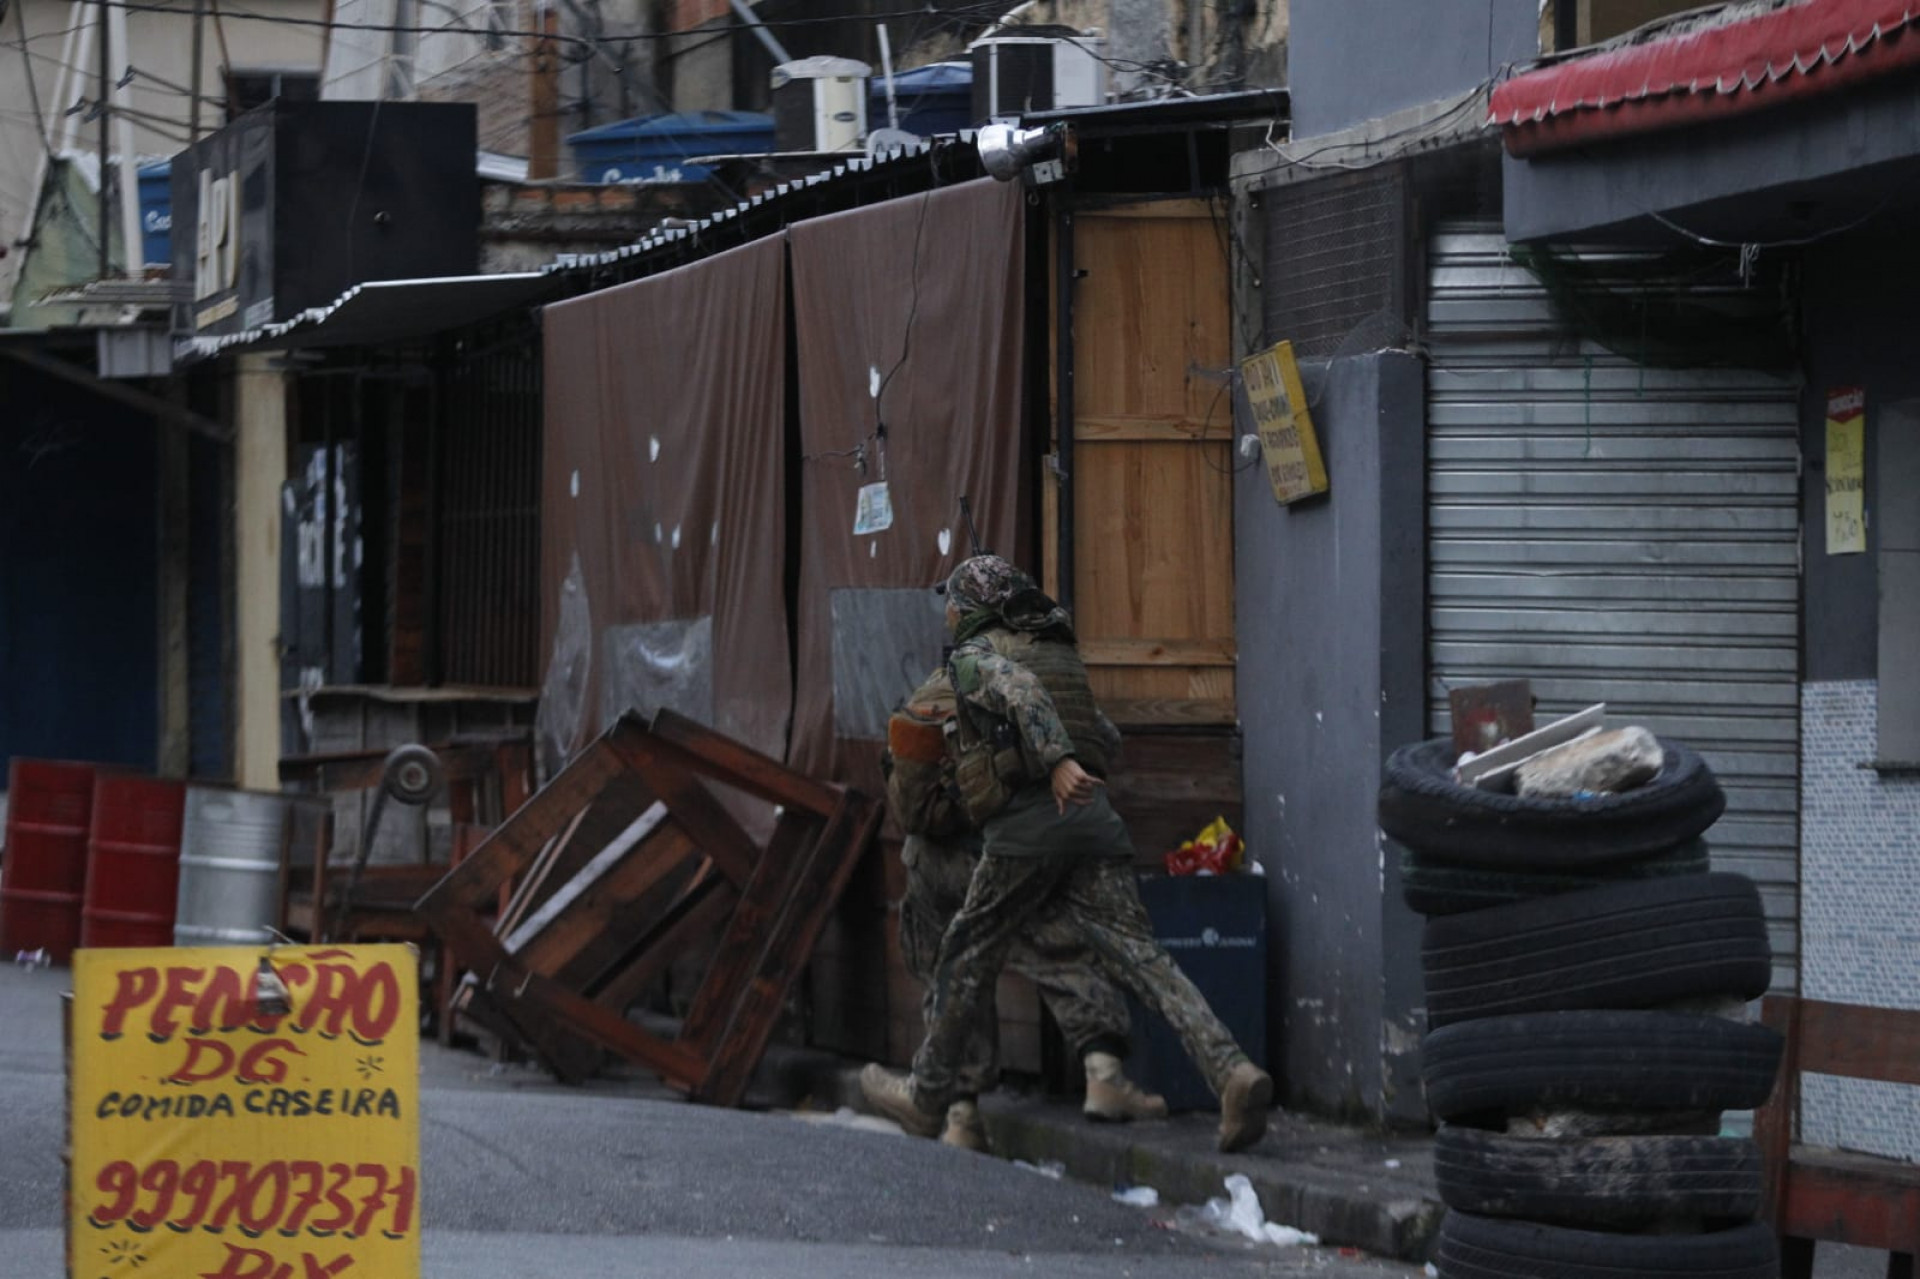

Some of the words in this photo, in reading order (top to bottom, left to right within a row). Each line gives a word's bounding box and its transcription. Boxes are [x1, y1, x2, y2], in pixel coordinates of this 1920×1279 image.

[96, 1091, 235, 1120] COMIDA
[245, 1088, 400, 1118] CASEIRA
[93, 1160, 415, 1237] 999707371
